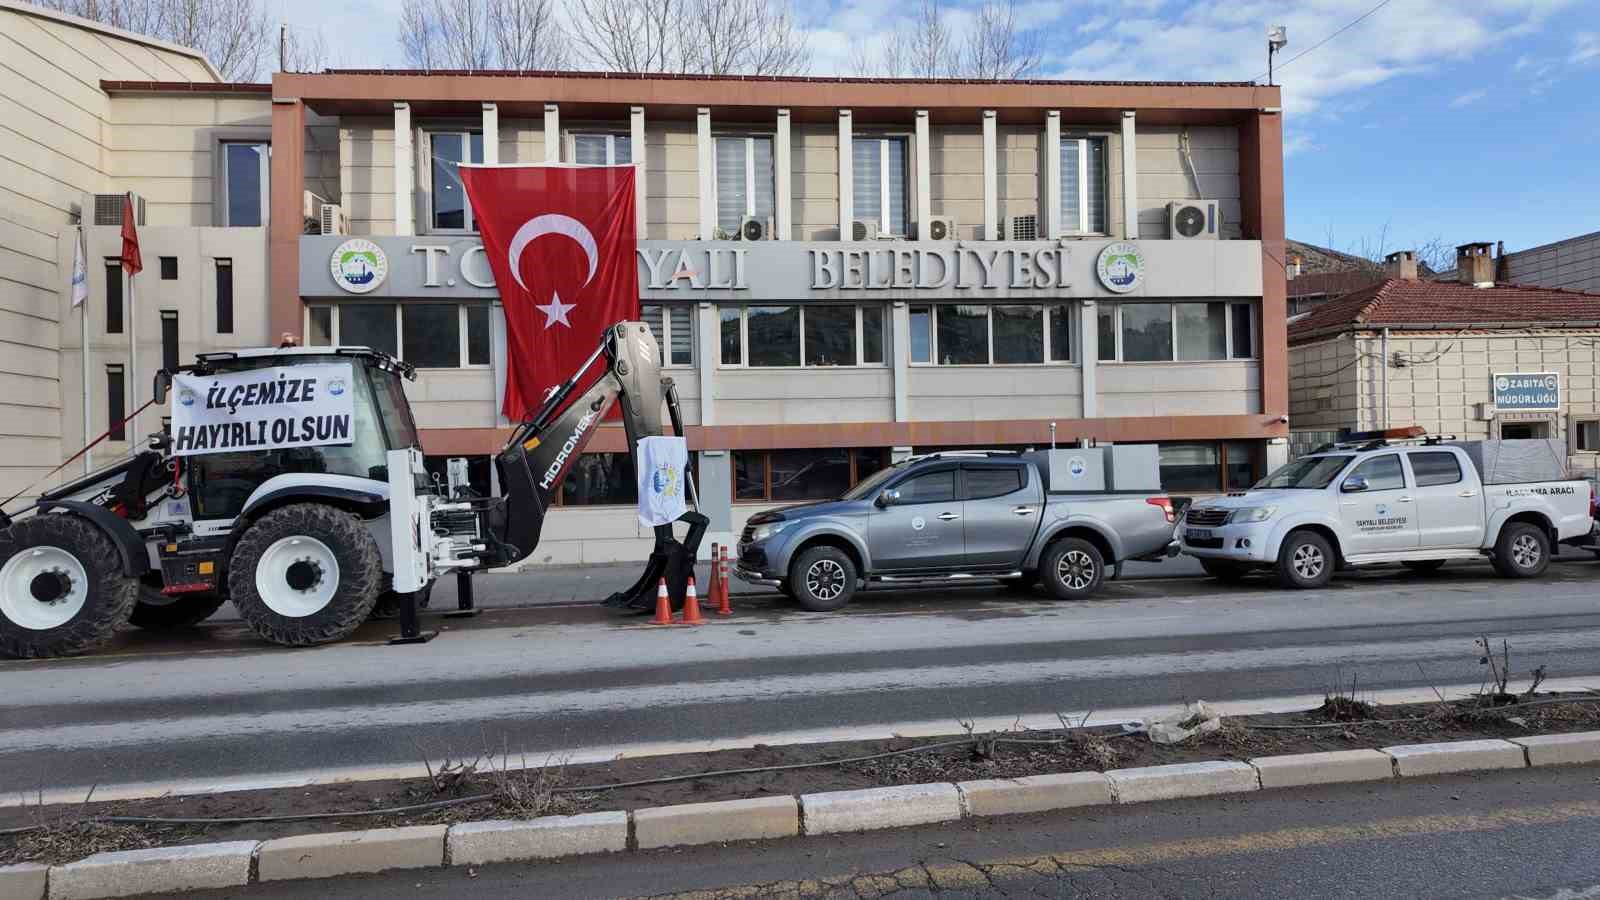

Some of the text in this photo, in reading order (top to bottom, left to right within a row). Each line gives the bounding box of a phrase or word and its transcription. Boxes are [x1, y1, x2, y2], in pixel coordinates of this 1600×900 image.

[809, 240, 1073, 289] BELEDİYESİ
[206, 373, 316, 414] İLÇEMİZE
[1497, 392, 1556, 405] MÜDÜRLÜĞÜ
[176, 414, 350, 450] HAYIRLI OLSUN
